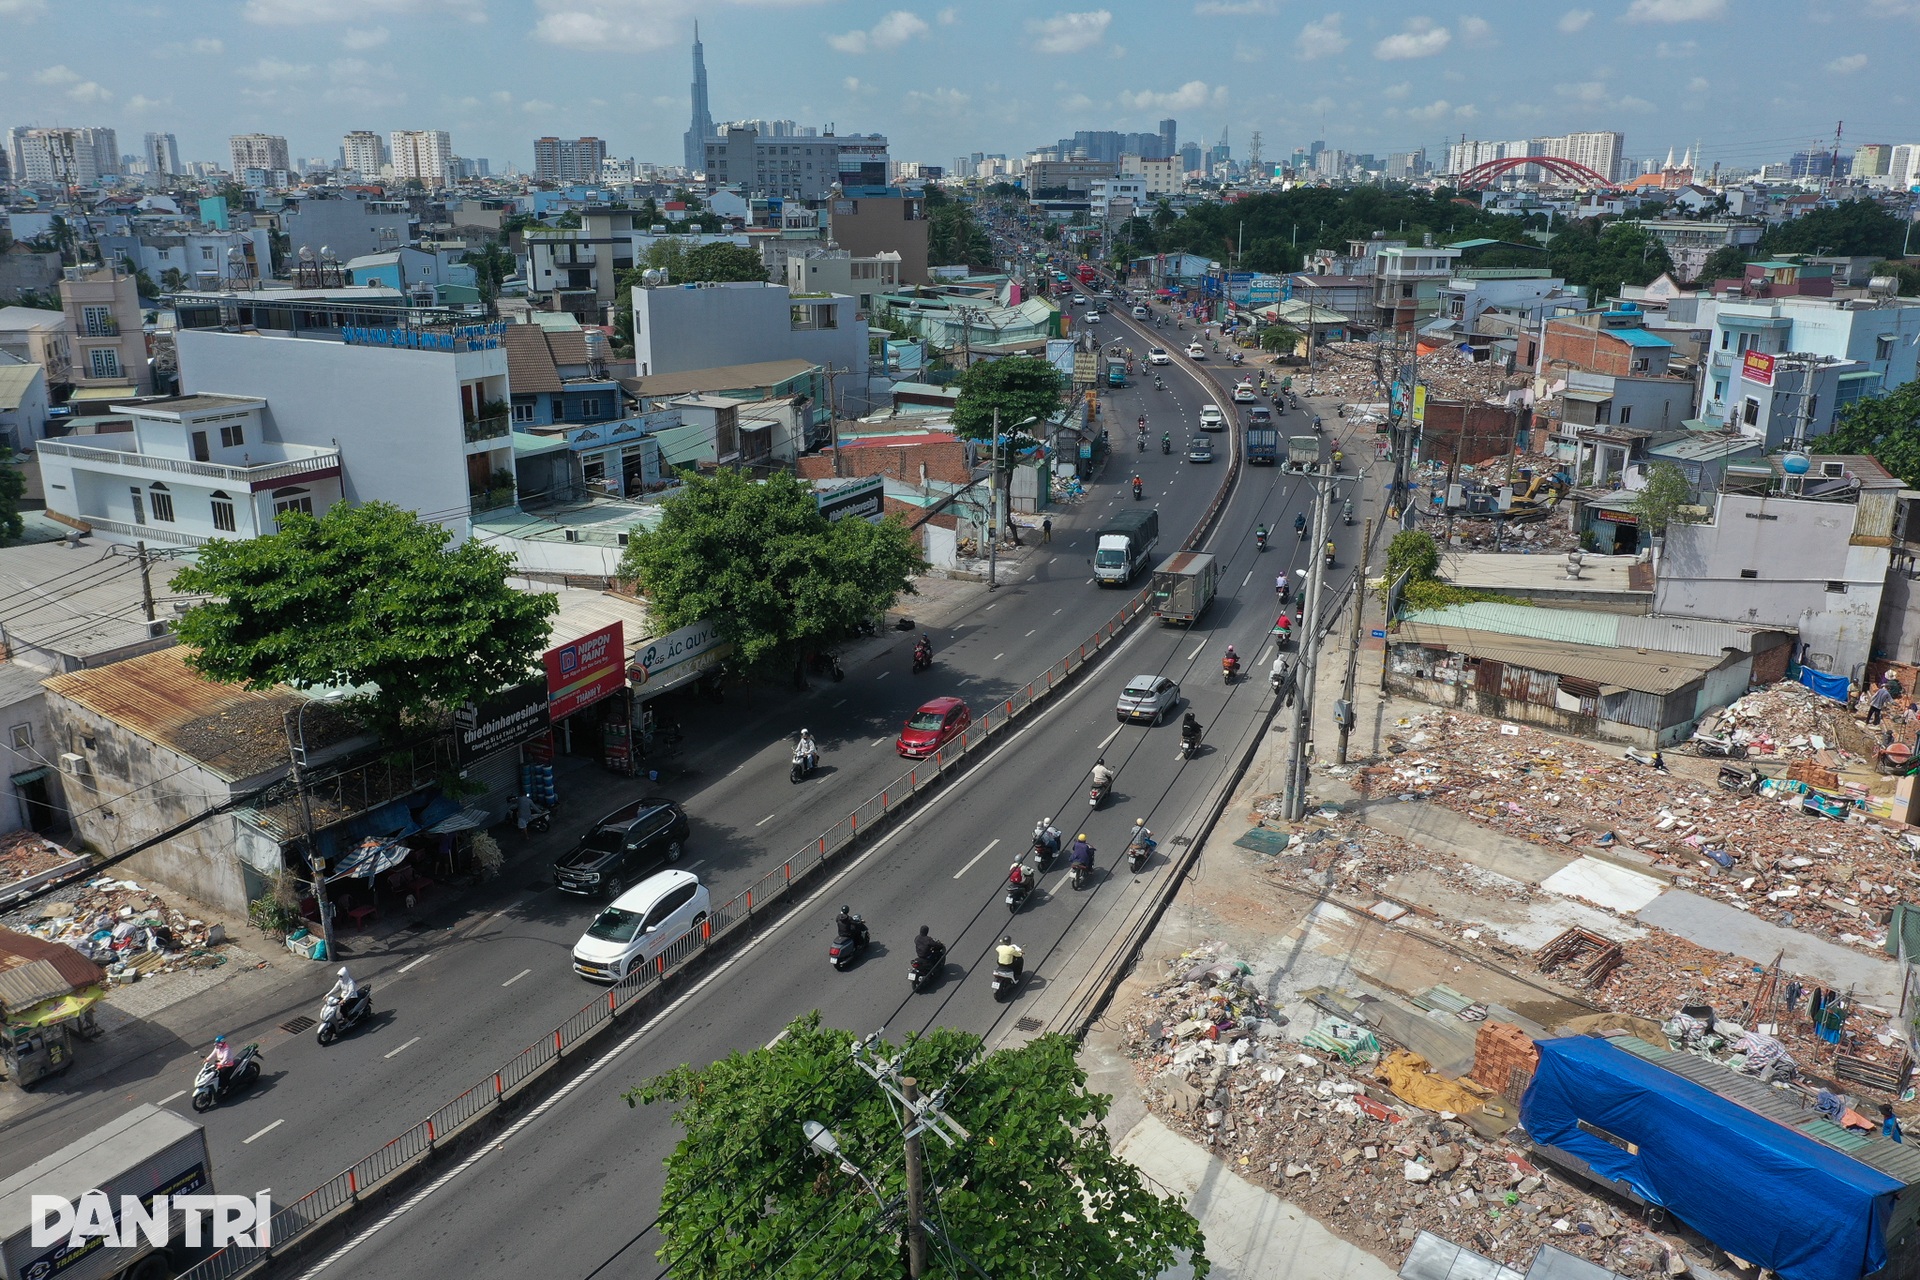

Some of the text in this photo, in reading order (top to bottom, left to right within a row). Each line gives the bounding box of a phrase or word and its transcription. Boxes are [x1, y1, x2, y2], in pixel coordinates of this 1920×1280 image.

[578, 634, 611, 655] NIPPON
[685, 629, 709, 650] QUY
[581, 645, 606, 665] PAINT
[463, 701, 548, 744] thietbinhavesinh.net
